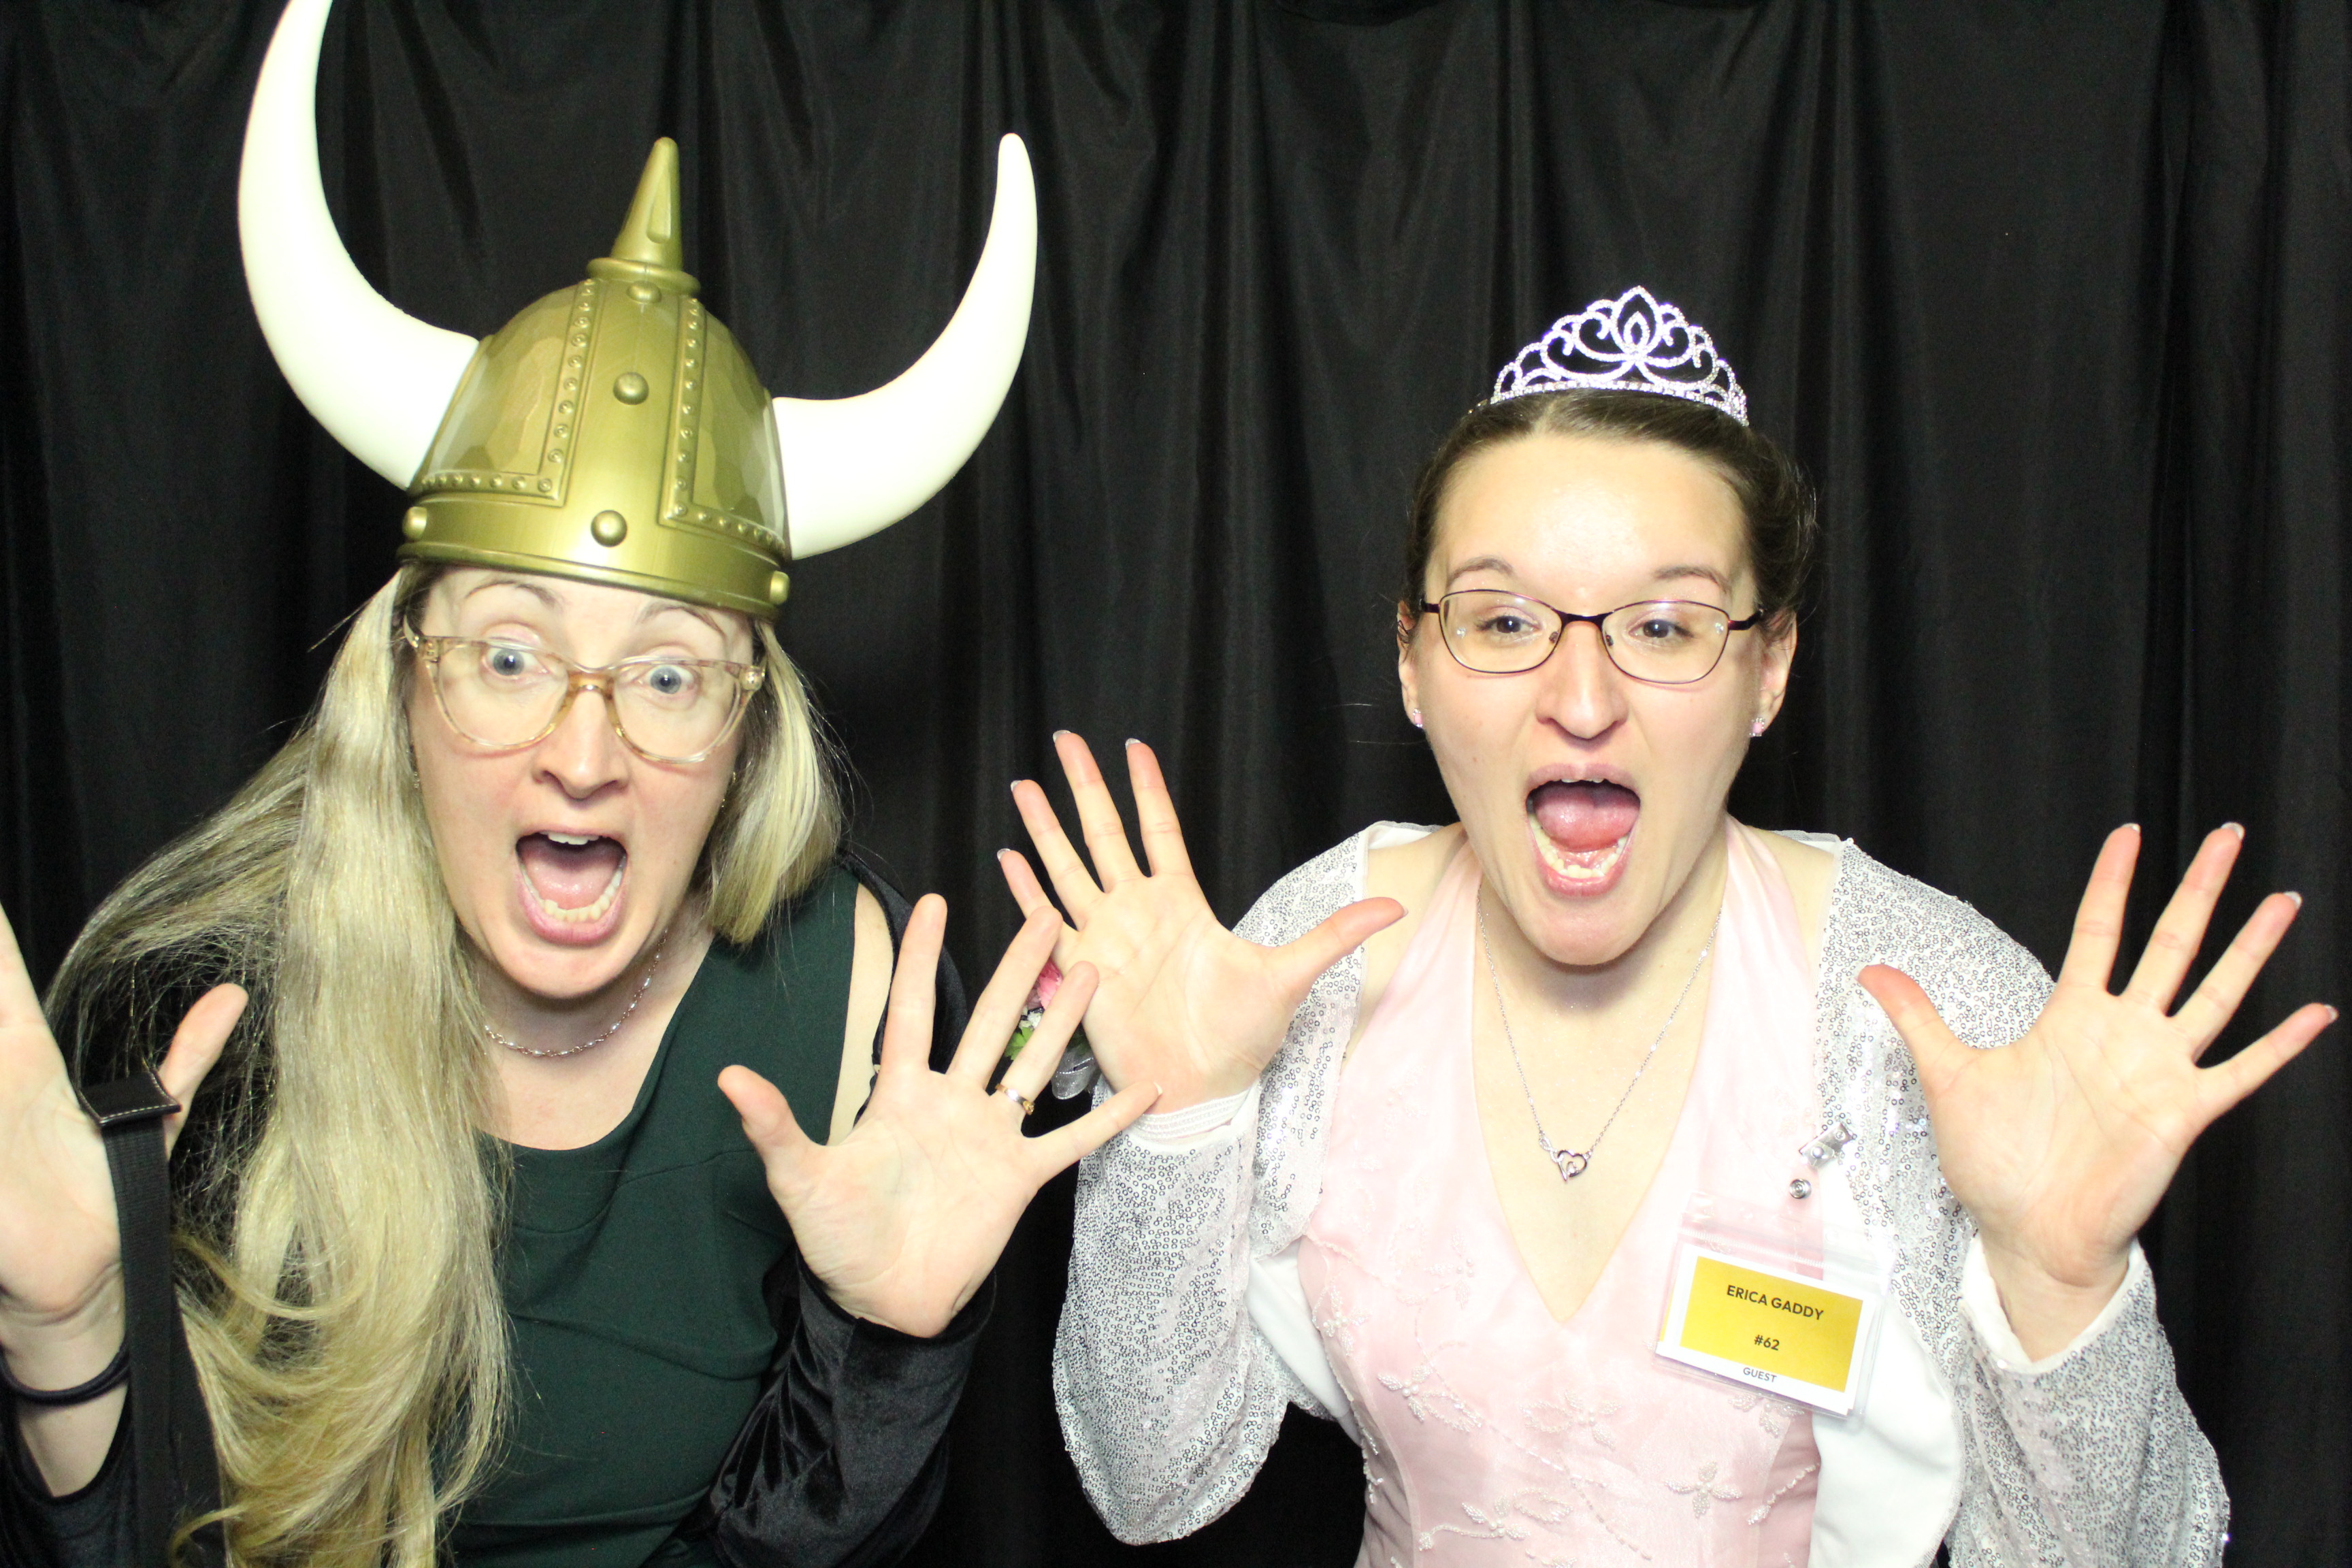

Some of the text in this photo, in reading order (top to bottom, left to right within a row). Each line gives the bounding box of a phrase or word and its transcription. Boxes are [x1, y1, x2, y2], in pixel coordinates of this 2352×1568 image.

[1727, 1285, 1824, 1320] ERICA GADDY
[1754, 1335, 1780, 1351] #62
[1743, 1367, 1777, 1383] GUEST
